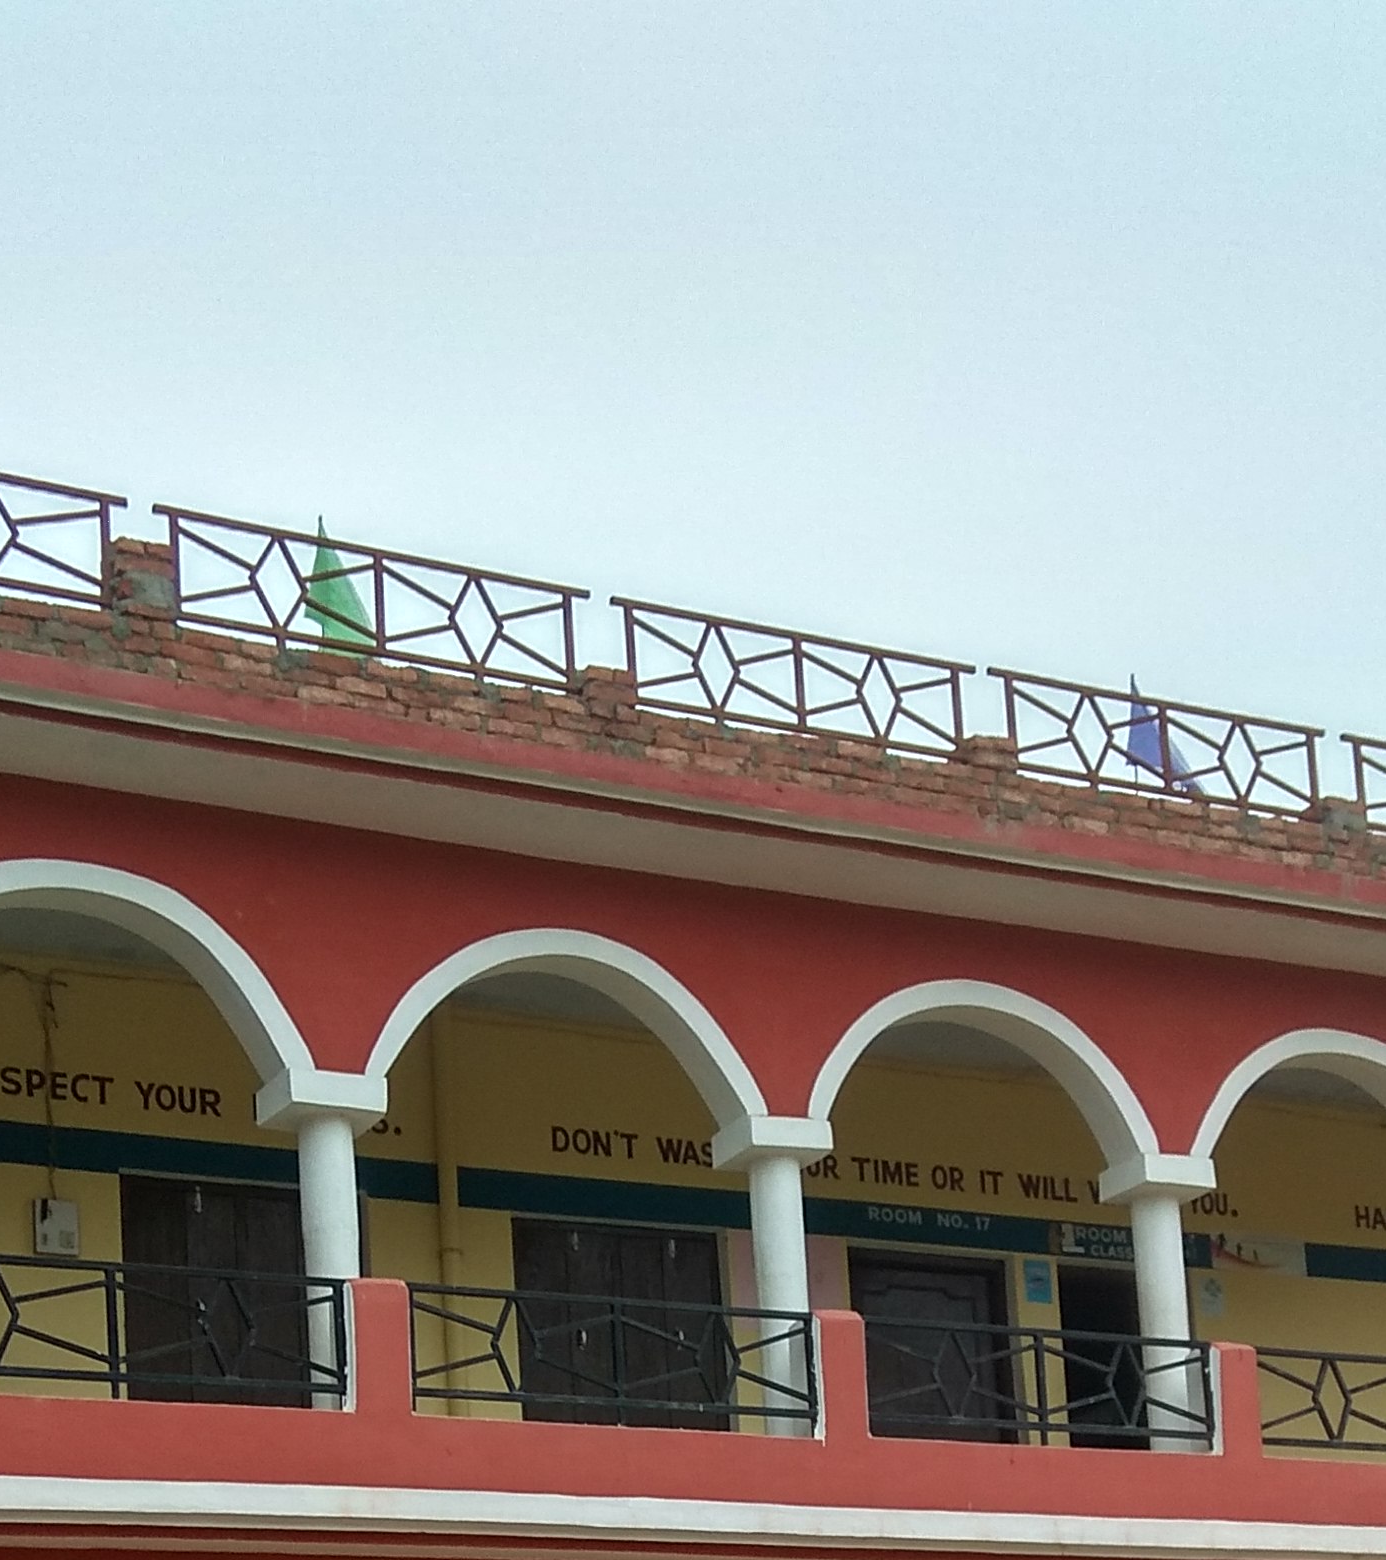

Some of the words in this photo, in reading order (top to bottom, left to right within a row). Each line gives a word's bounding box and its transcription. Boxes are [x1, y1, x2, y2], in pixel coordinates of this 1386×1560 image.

[135, 1081, 221, 1117] YOUR
[551, 1126, 638, 1159] DON'T
[657, 1137, 713, 1167] WAS
[851, 1157, 919, 1187] TIME
[931, 1165, 965, 1192] OR
[980, 1169, 1004, 1195] IT
[1018, 1173, 1077, 1202] WILL
[868, 1206, 922, 1225] ROOM
[1074, 1226, 1127, 1244] ROOM
